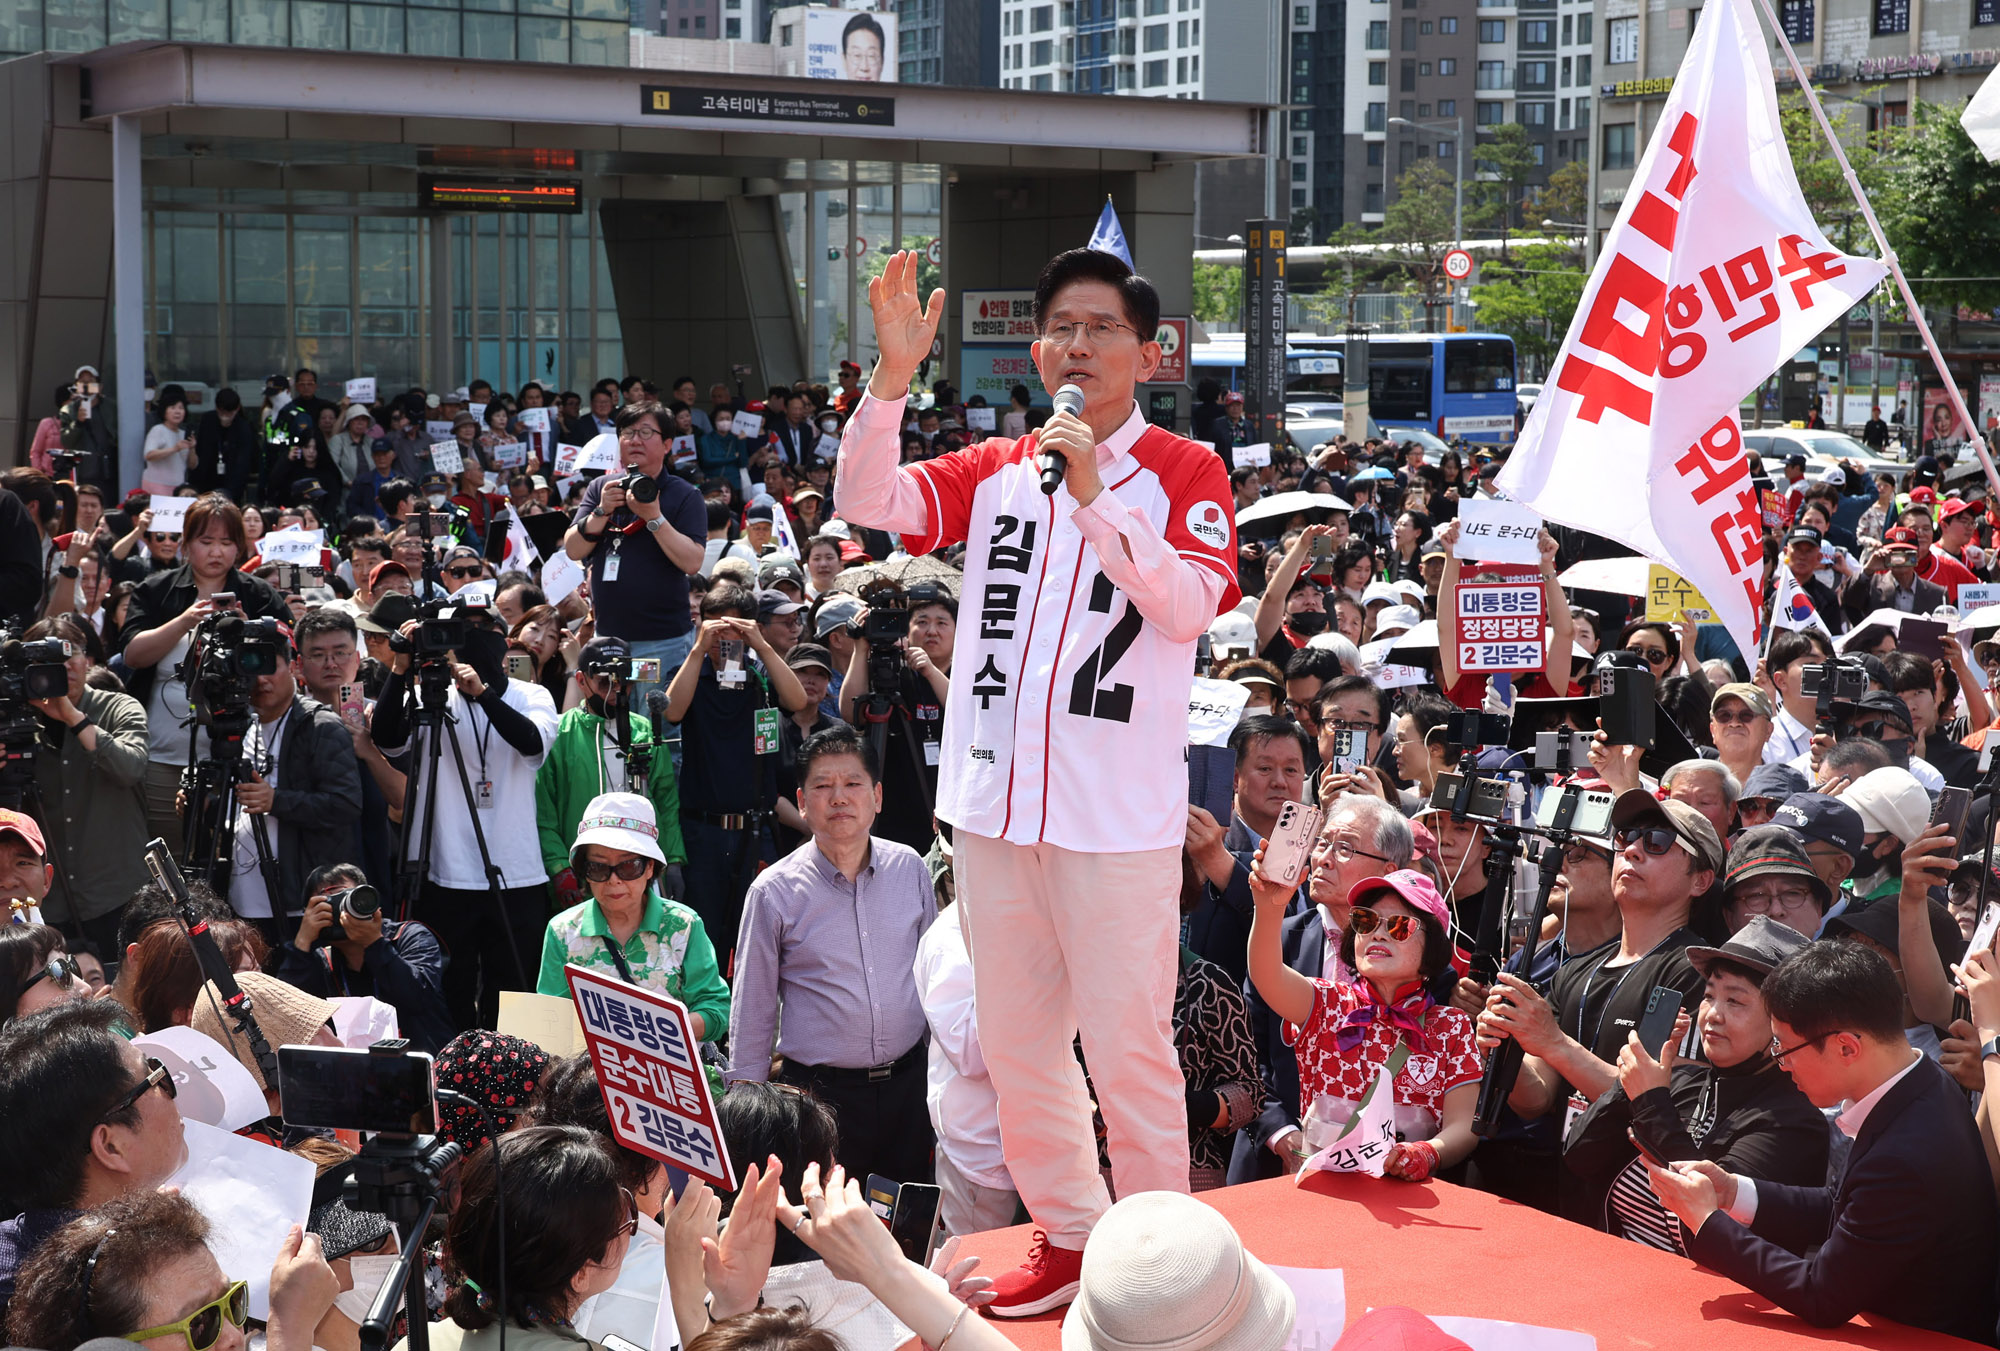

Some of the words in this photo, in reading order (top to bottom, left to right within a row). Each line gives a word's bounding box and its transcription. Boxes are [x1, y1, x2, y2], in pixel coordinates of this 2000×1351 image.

[658, 94, 664, 107] 1
[702, 95, 770, 114] 고속터미널
[774, 98, 798, 108] Express
[799, 100, 810, 108] Bus
[812, 101, 839, 110] Terminal
[1276, 257, 1284, 277] 1
[1449, 258, 1466, 271] 50
[990, 300, 1010, 318] 헌혈
[1272, 280, 1284, 346] 고속터미널
[972, 321, 1005, 335] 헌혈의집
[992, 359, 1027, 374] 건강계단
[1158, 358, 1181, 367] 피소
[1497, 378, 1512, 389] 361
[562, 447, 578, 461] 2
[557, 461, 576, 472] 김문
[1193, 524, 1226, 542] 국민의힘
[1465, 523, 1492, 536] 나도
[1497, 526, 1537, 539] 문수다
[1463, 592, 1538, 613] 대통령은
[971, 514, 1036, 710] 김문수
[1462, 618, 1539, 640] 정정당당
[1068, 569, 1144, 723] 2
[1464, 647, 1476, 664] 2
[1482, 645, 1538, 665] 김문수
[1382, 668, 1394, 680] 승
[971, 748, 995, 763] 국민의힘
[580, 988, 687, 1062] 대통령은
[596, 1042, 701, 1116] 문수대통
[1572, 1102, 1584, 1110] PRESS
[614, 1096, 636, 1133] 2
[636, 1103, 715, 1167] 김문수
